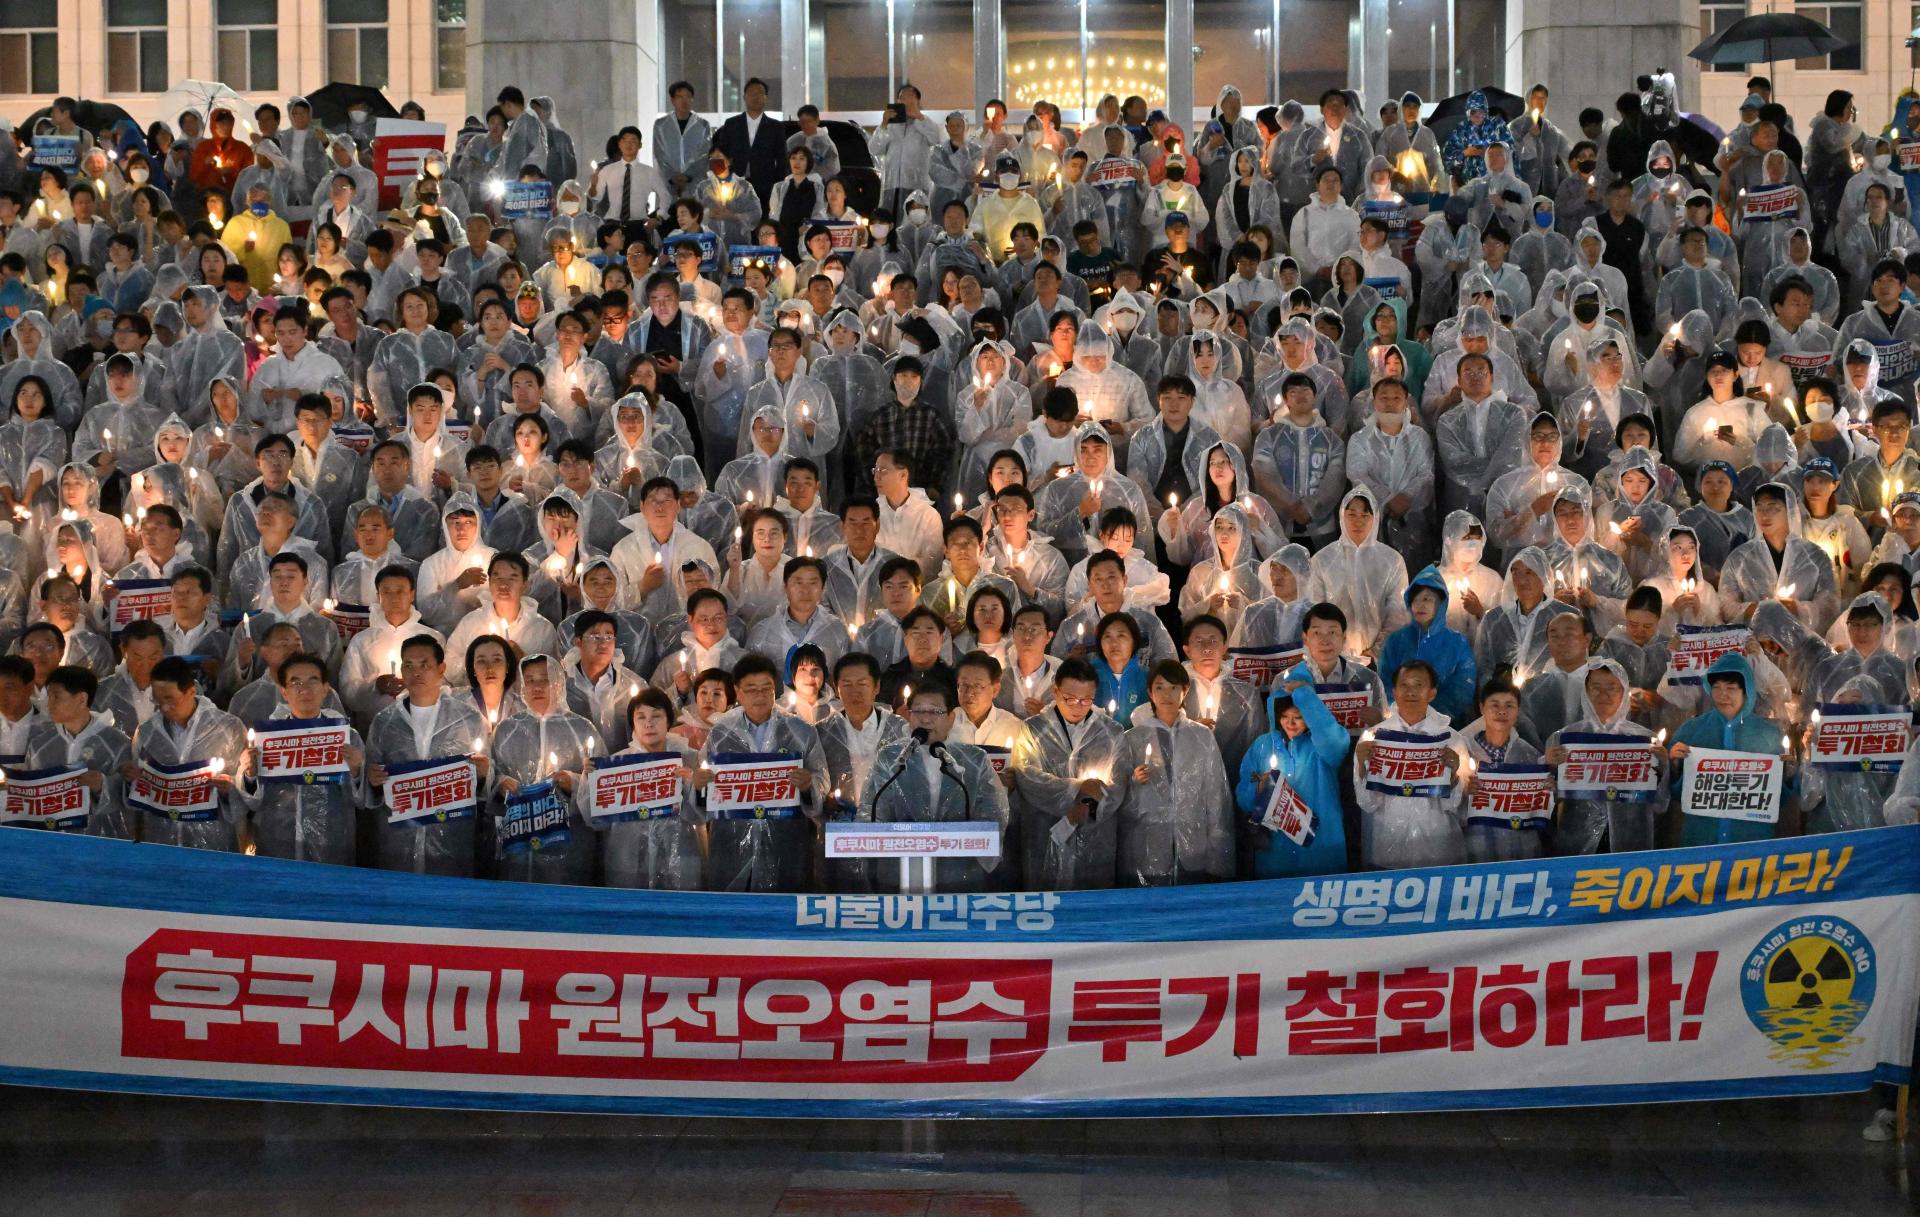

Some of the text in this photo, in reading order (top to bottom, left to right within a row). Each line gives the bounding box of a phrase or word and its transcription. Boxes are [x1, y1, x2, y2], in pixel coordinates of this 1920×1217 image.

[1681, 641, 1705, 651] 쿠시마
[1823, 722, 1904, 733] 후쿠시마 원전오염수
[265, 735, 343, 750] 후쿠시마 원전오염수
[1817, 734, 1905, 755] 투기철회
[262, 746, 344, 770] 투기철회
[1376, 749, 1441, 760] 쿠시마 원전오염
[1570, 752, 1650, 761] 후쿠시마 원전오염수
[600, 766, 675, 787] 후쿠시마 원전오염수
[719, 771, 751, 782] 후쿠시마
[1564, 763, 1651, 783] 투기철회
[1703, 762, 1767, 771] 후쿠시마 오염수
[395, 768, 469, 792] 후쿠시마 원전오염수
[1481, 782, 1510, 791] 쿠시마
[1695, 773, 1770, 791] 해양투기
[6, 788, 83, 815] 투기철회
[135, 778, 211, 806] 투기철회
[392, 780, 472, 814] 투기철회
[596, 779, 676, 808] 투기철회
[713, 780, 797, 803] 투기철회
[1471, 791, 1551, 813] 투기철회
[1691, 792, 1772, 811] 반대한다!
[534, 809, 564, 831] 마라!
[837, 838, 990, 850] 후쿠시마 원전오염수 투기 철회!
[1293, 846, 1855, 927] 생명의 바다, 죽이지 마라!
[796, 892, 1061, 931] 더불어민주당
[1747, 920, 1871, 983] 후쿠시마 원전 오염수 NO
[150, 948, 1720, 1064] 후쿠시마 원전오염수 투기 철회하라!
